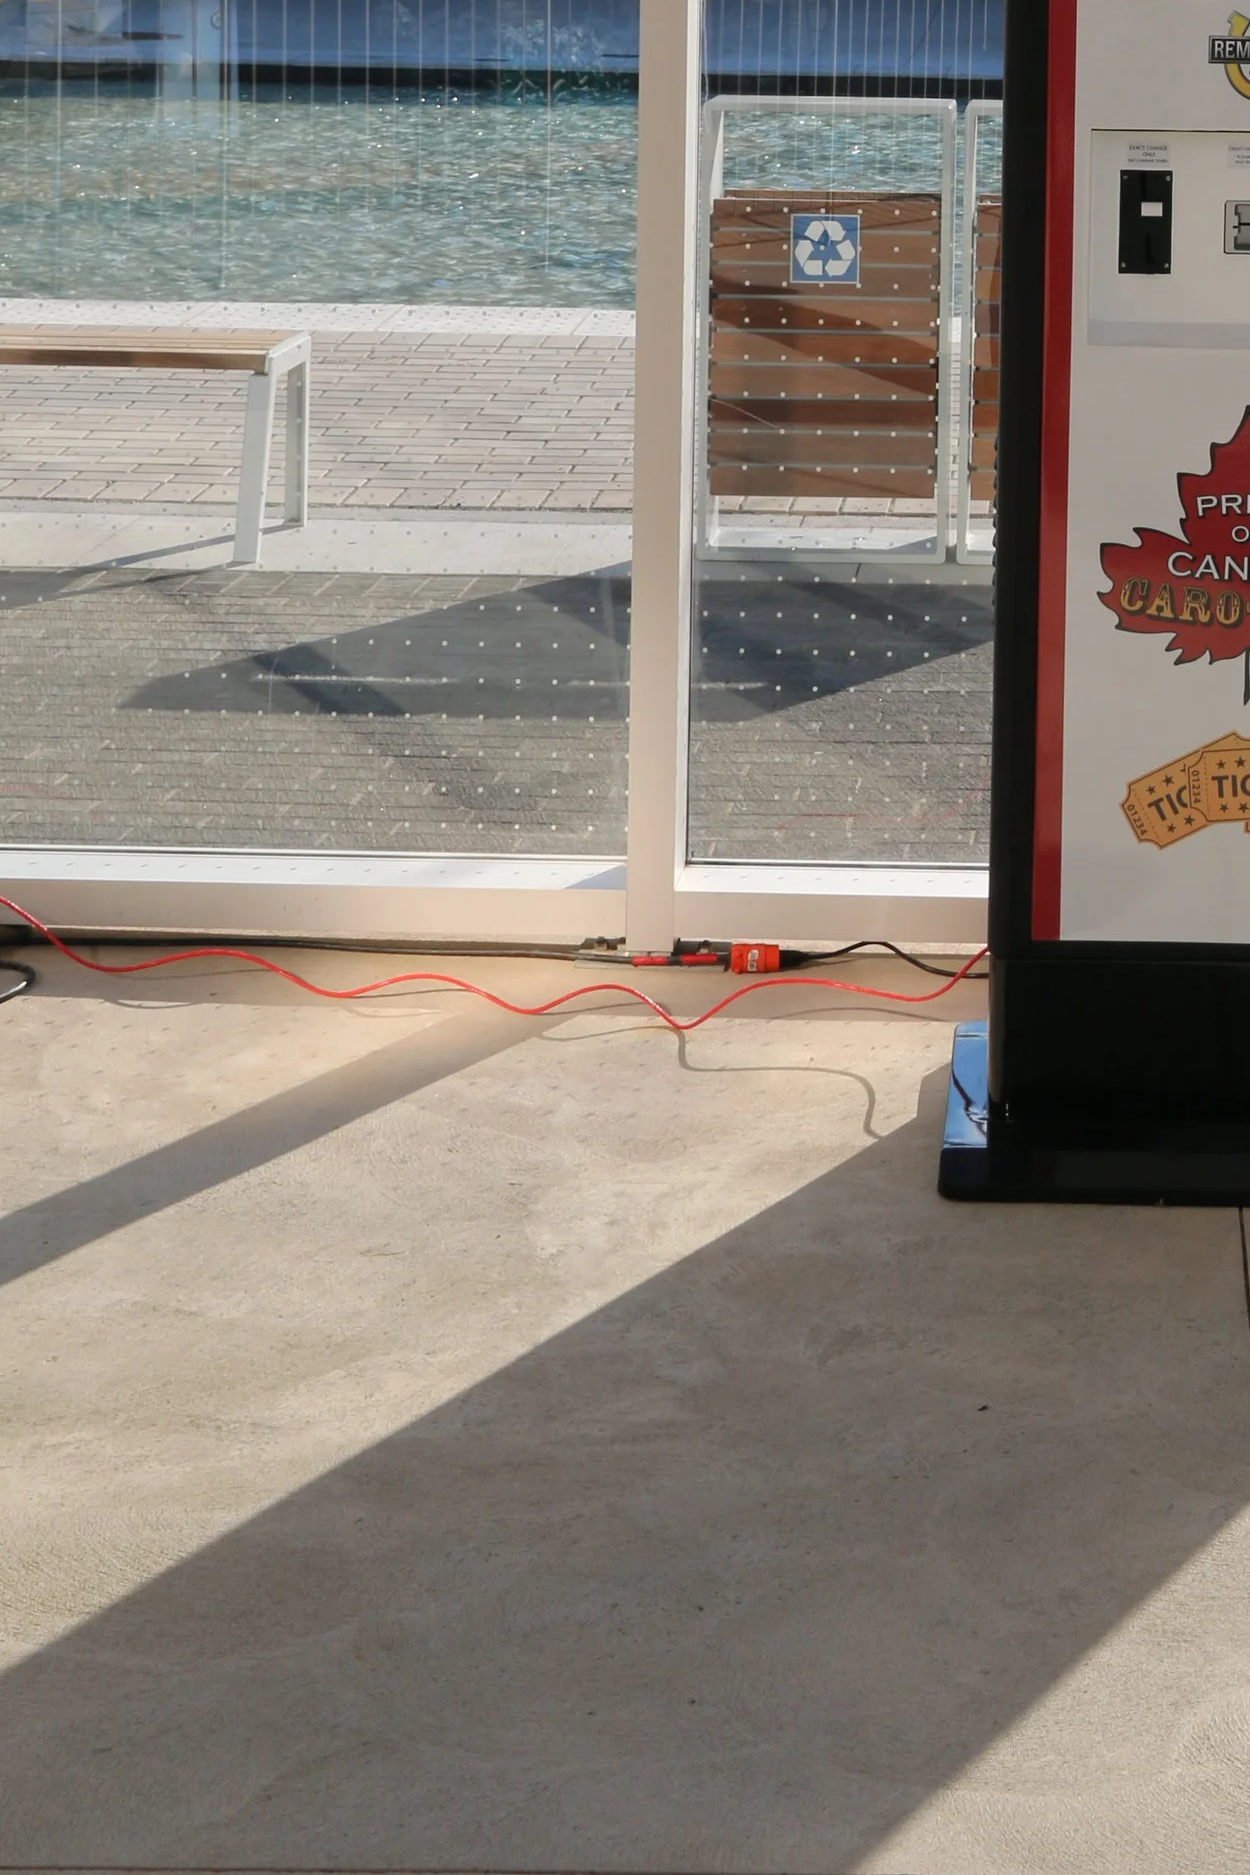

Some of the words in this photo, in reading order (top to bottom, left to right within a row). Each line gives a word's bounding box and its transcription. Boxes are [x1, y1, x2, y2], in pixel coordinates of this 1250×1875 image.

[1147, 784, 1188, 822] TIC
[1191, 770, 1201, 805] 01234
[1126, 803, 1149, 837] 01234
